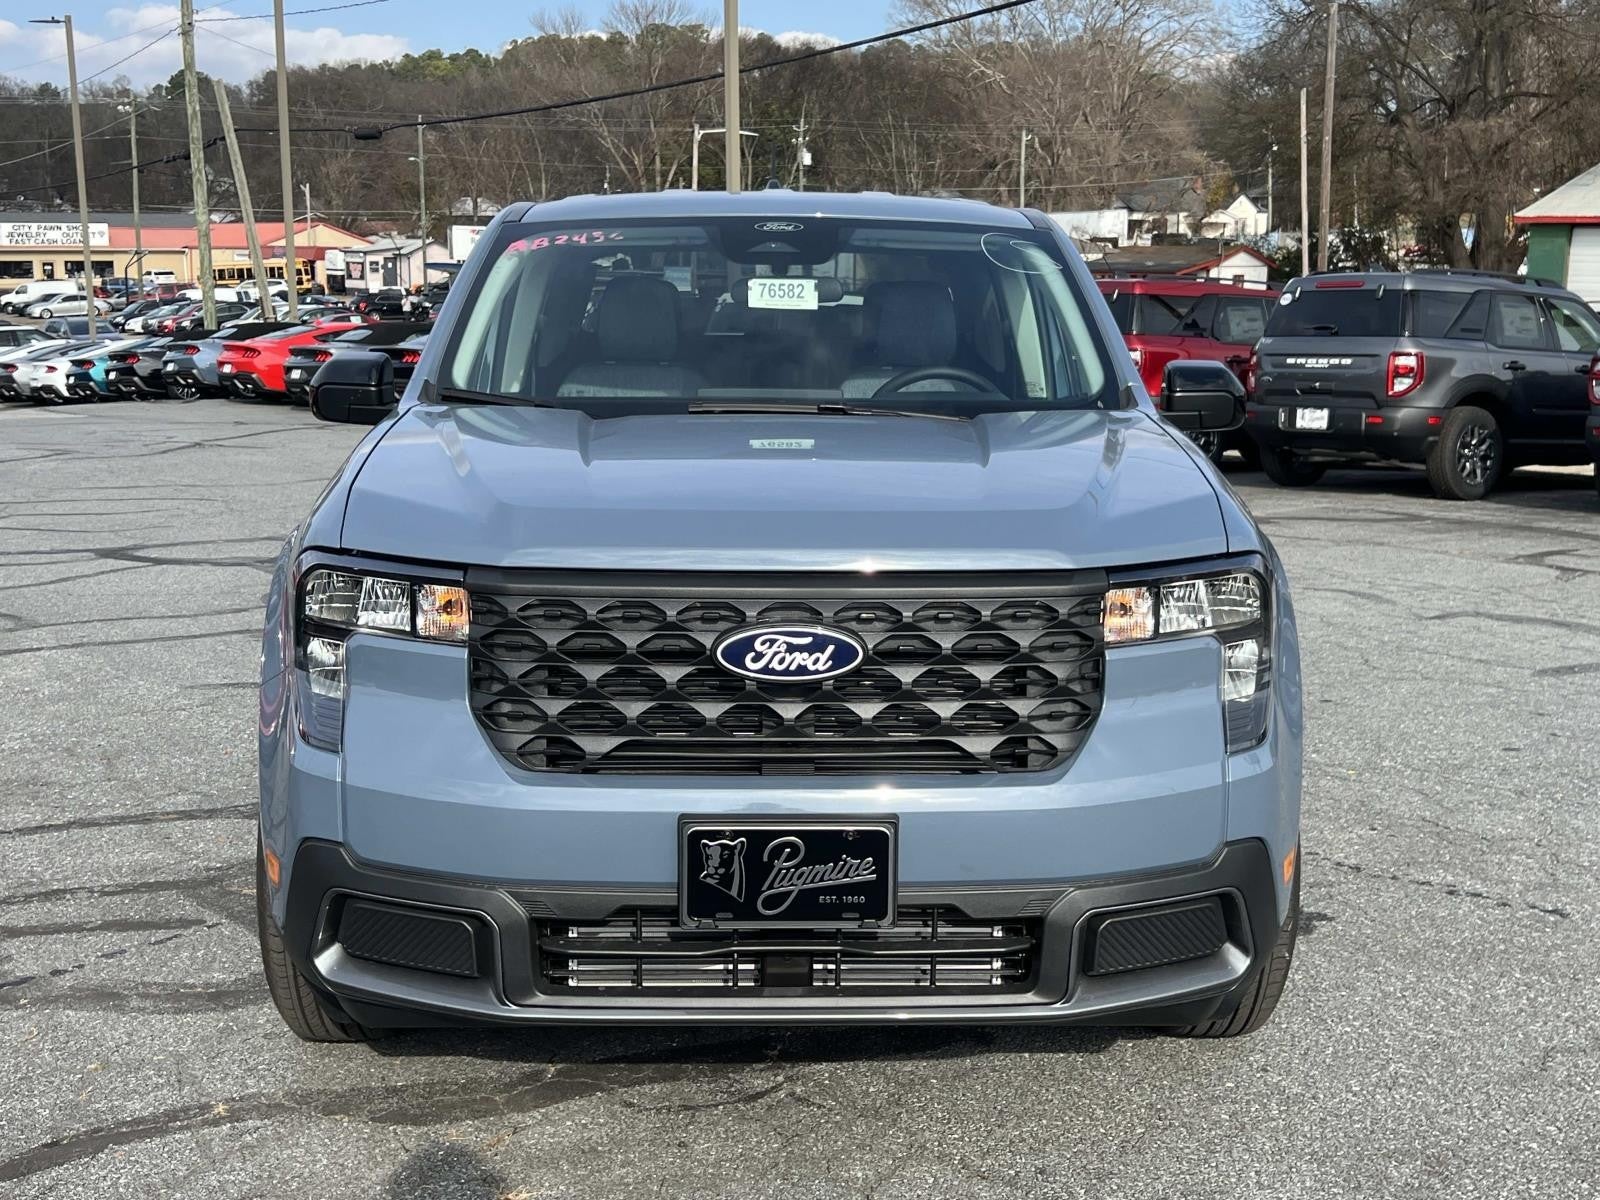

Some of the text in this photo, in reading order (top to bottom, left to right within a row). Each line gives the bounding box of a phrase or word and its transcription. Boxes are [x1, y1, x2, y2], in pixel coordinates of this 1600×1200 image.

[763, 223, 795, 231] Ford
[758, 282, 805, 299] 76582
[744, 634, 836, 671] Ford
[756, 836, 877, 916] Pugmire
